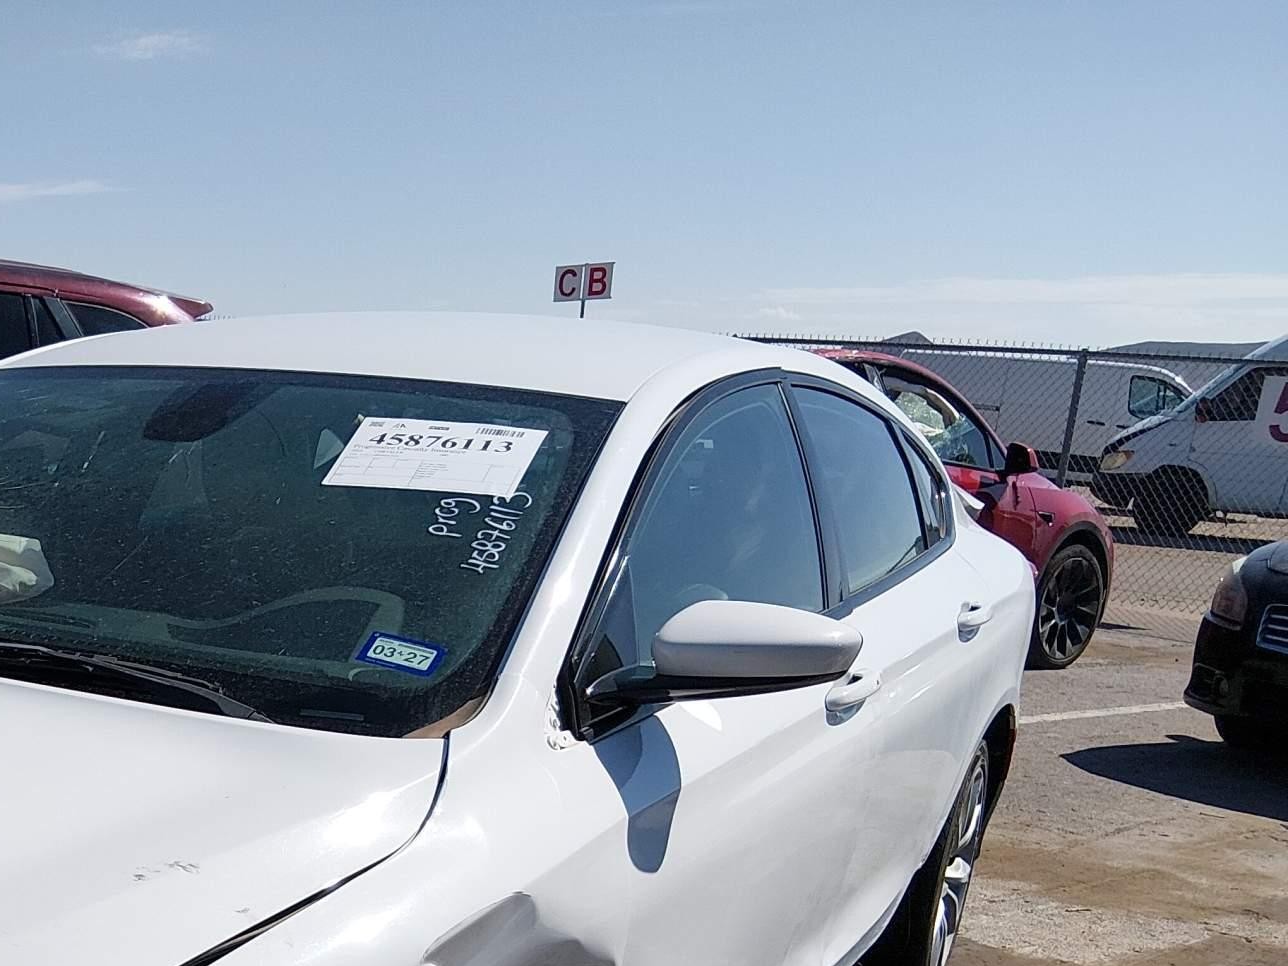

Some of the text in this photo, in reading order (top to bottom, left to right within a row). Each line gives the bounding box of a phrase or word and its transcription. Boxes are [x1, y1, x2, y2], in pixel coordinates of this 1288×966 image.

[558, 266, 608, 298] C B
[369, 432, 514, 453] 45876113
[460, 491, 533, 574] 45876113
